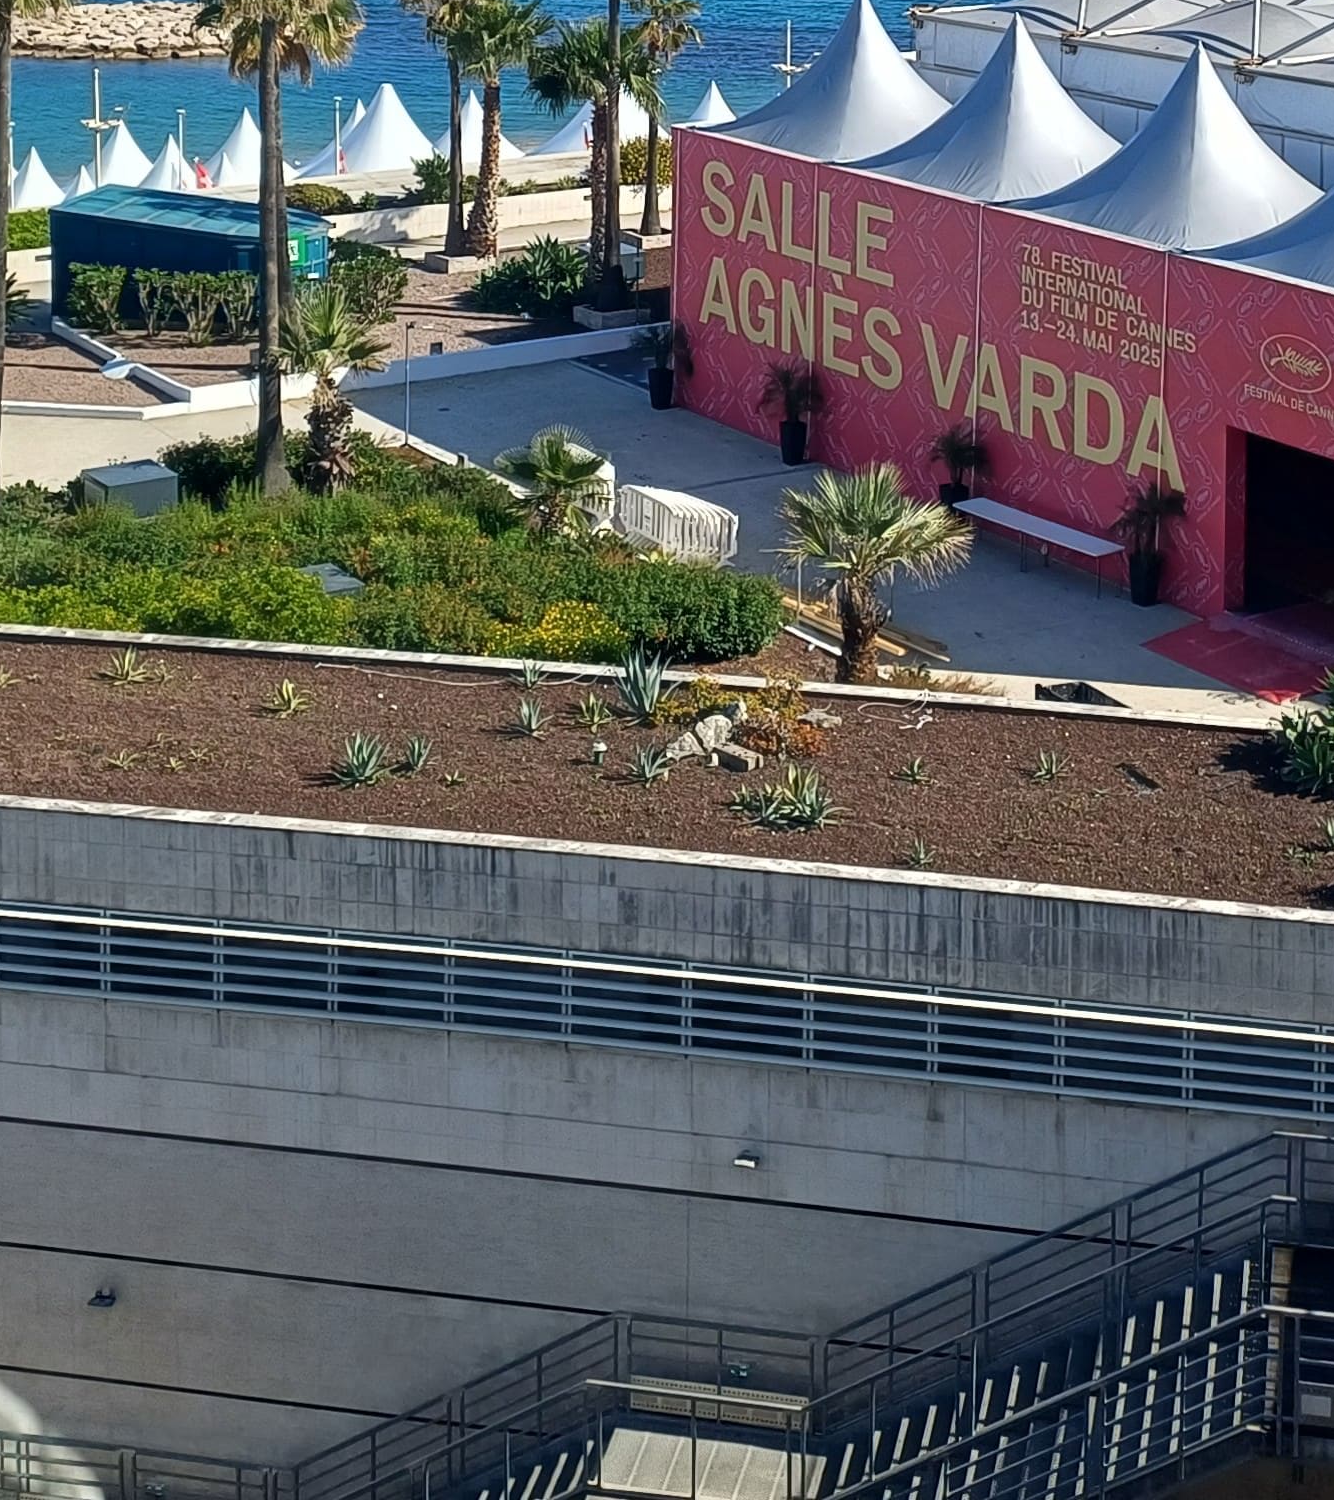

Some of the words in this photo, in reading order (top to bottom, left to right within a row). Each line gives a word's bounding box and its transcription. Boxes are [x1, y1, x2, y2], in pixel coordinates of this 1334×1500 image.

[700, 160, 894, 288] SALLE
[1021, 264, 1148, 318] INTERNATIONAL
[1022, 244, 1044, 267] 78.
[1051, 251, 1128, 290] FESTIVAL
[1021, 286, 1043, 309] DU
[1050, 294, 1088, 323] FILM
[1095, 308, 1118, 331] DE
[1126, 317, 1197, 353] CANNES
[699, 256, 903, 390] AGNÈS
[920, 321, 1186, 493] VARDA
[1082, 328, 1112, 354] MAI
[1120, 339, 1161, 368] 2025
[1244, 383, 1289, 408] FESTIVAL
[1290, 398, 1305, 412] DE
